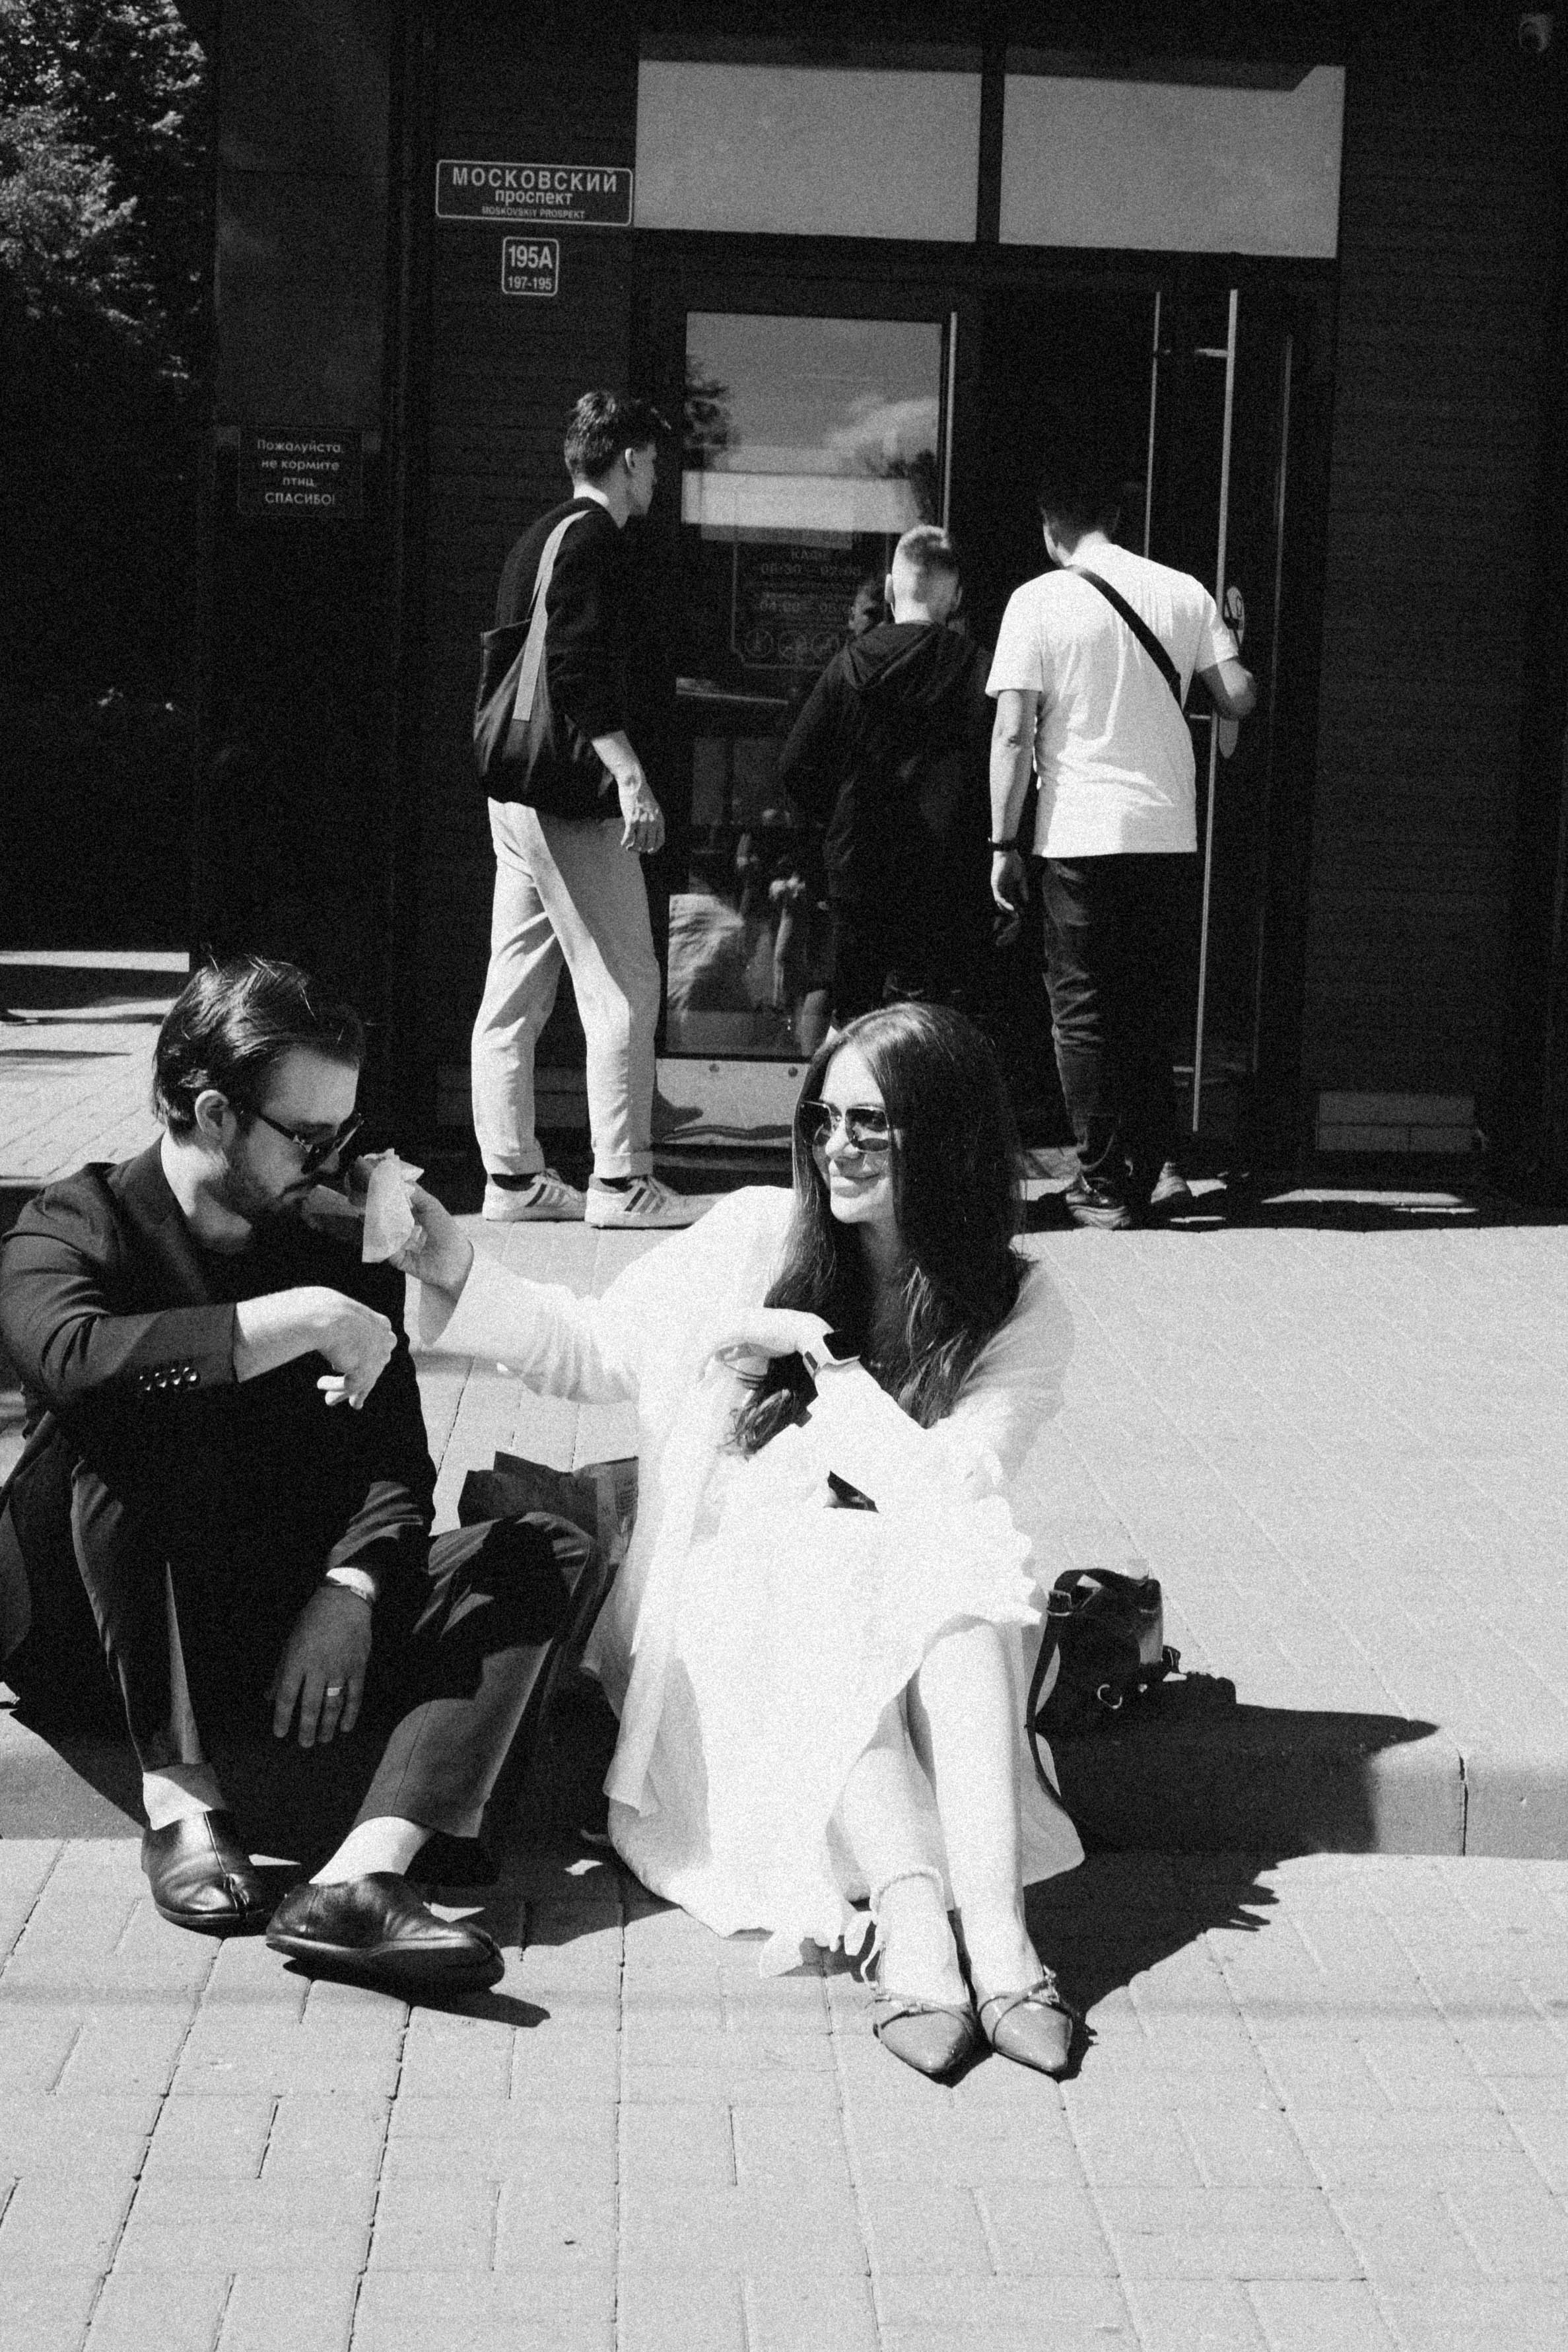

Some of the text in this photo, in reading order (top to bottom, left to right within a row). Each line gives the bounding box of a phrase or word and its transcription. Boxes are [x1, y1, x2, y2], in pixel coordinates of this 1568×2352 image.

[452, 166, 617, 192] МОСКОВСКИЙ
[495, 189, 573, 206] проспект
[540, 208, 586, 219] PROSPEKT
[508, 245, 553, 269] 195А
[508, 275, 553, 291] 197-195
[261, 459, 340, 472] не кормите
[265, 491, 335, 506] СПАСИБО!
